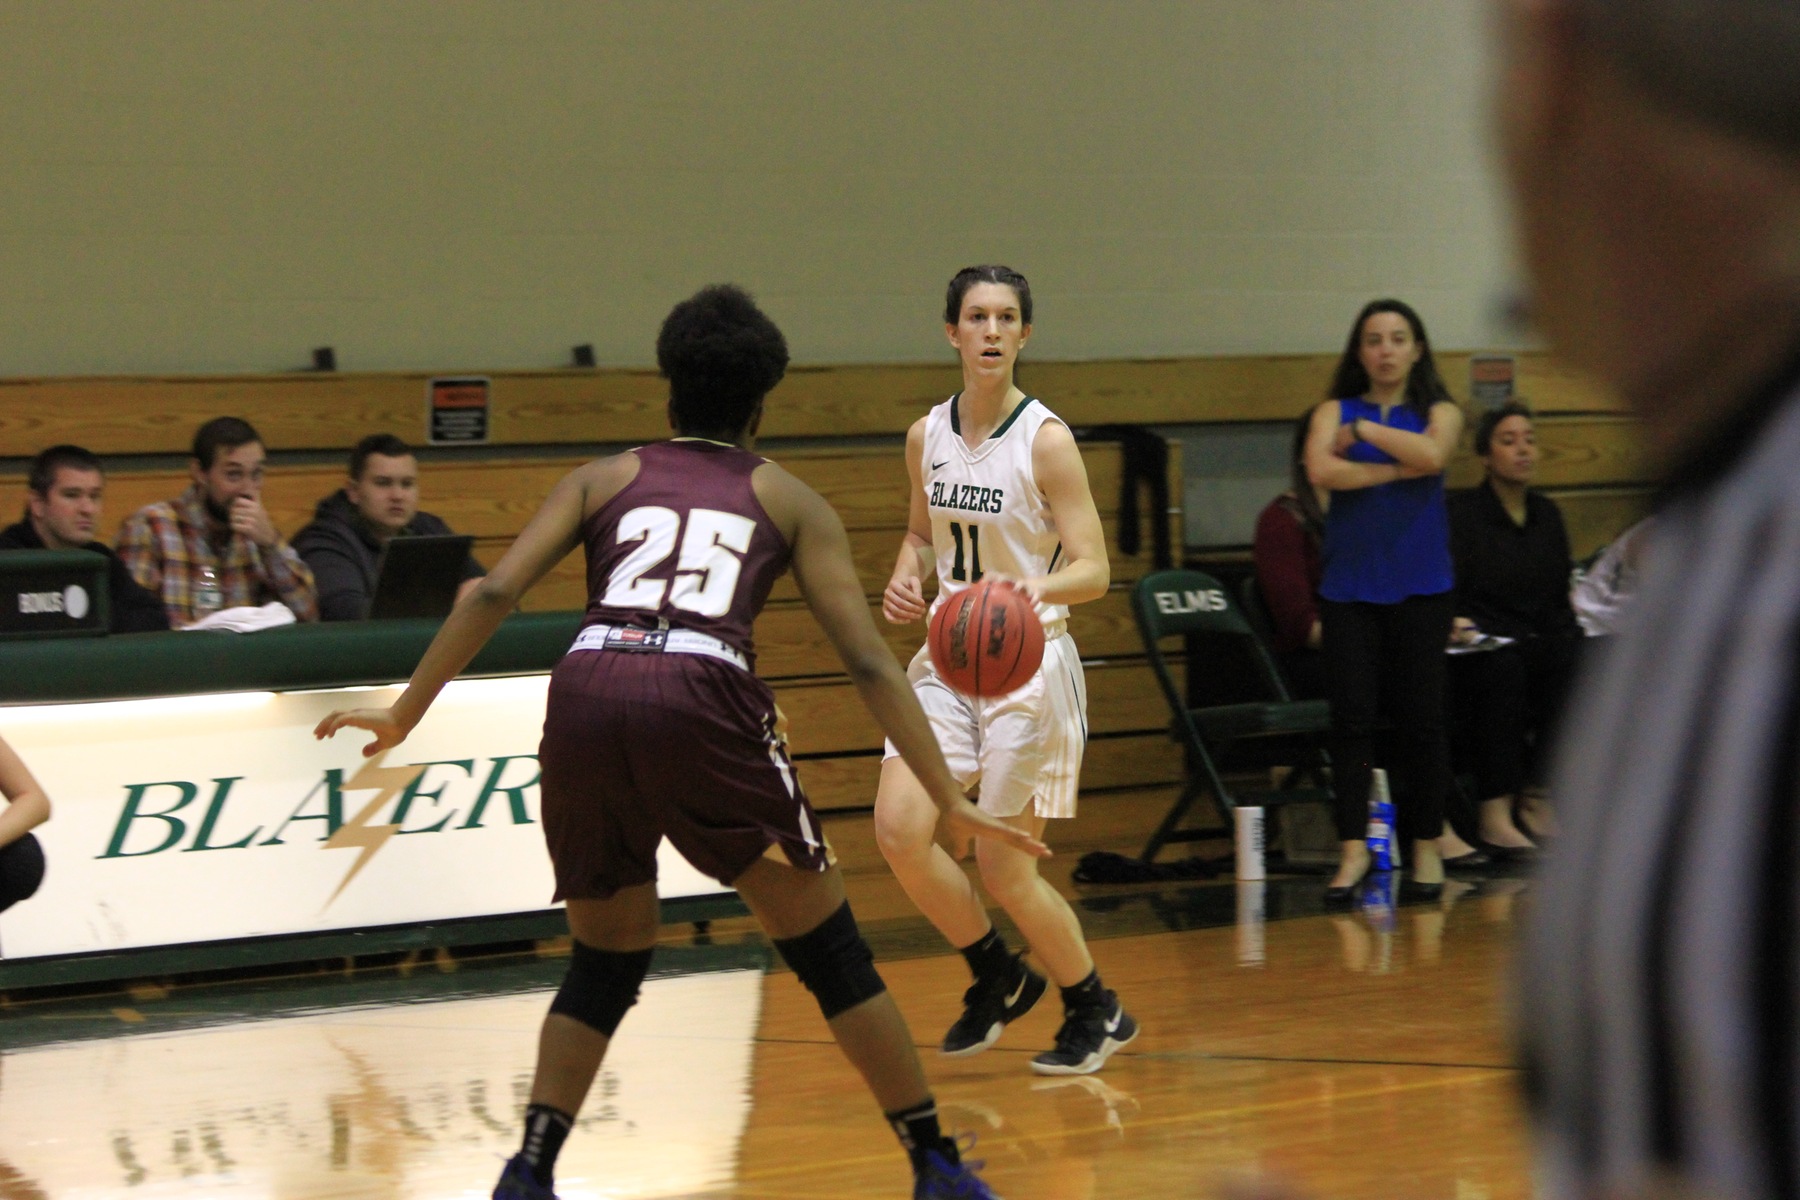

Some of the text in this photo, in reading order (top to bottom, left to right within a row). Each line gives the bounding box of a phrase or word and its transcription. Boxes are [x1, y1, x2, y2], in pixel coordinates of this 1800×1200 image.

[930, 481, 1004, 514] BLAZERS
[600, 505, 757, 618] 25
[950, 521, 984, 584] 11
[1153, 589, 1228, 614] ELMS
